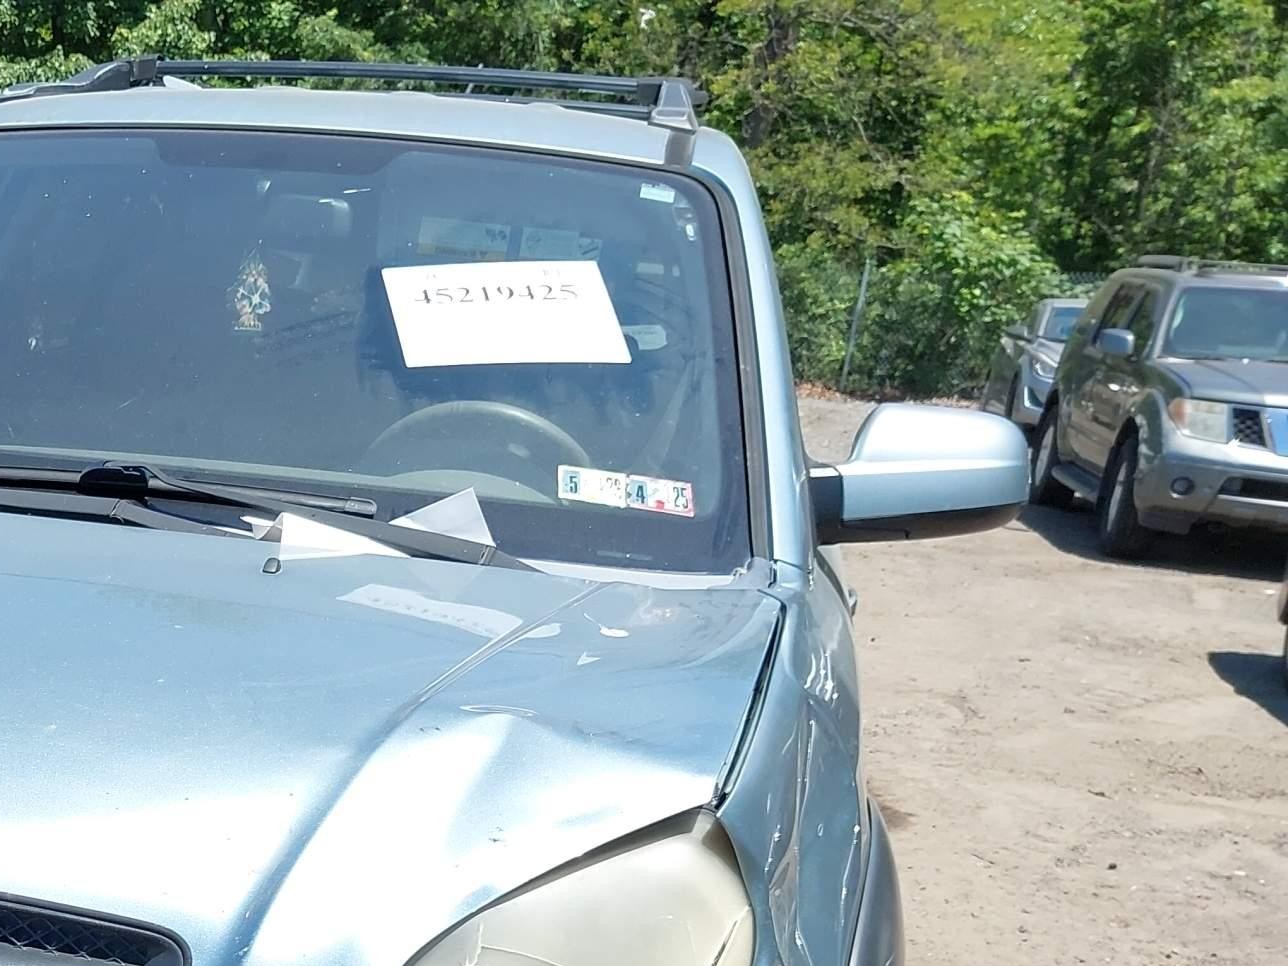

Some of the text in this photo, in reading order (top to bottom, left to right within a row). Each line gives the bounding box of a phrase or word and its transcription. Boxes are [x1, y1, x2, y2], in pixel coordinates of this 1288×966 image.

[414, 284, 579, 304] 45219425
[569, 475, 578, 494] 5
[636, 485, 689, 509] 4 25
